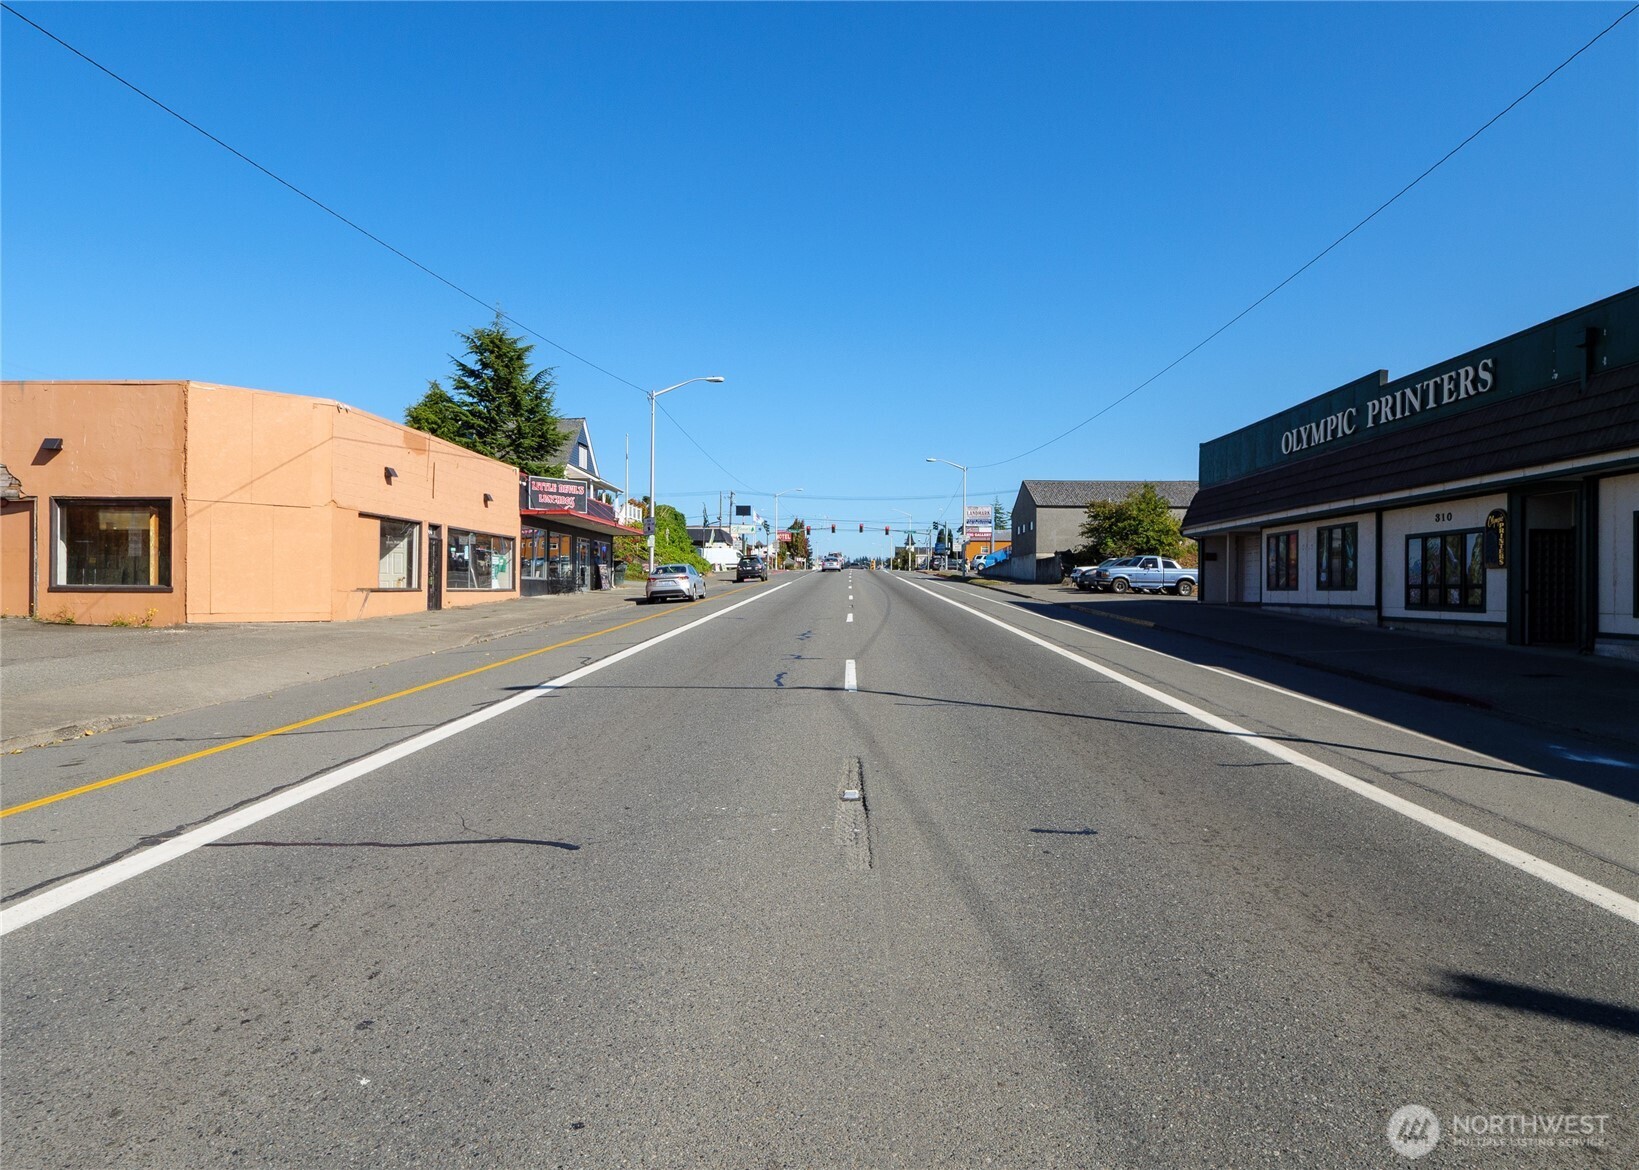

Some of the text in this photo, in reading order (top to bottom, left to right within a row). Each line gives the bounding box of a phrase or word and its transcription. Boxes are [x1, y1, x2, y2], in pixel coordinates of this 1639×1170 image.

[1281, 358, 1495, 455] OLYMPIC PRINTERS
[531, 481, 585, 495] LITTLE DEVIL'S
[538, 494, 575, 508] LUNCHBOX
[1434, 512, 1453, 523] 310
